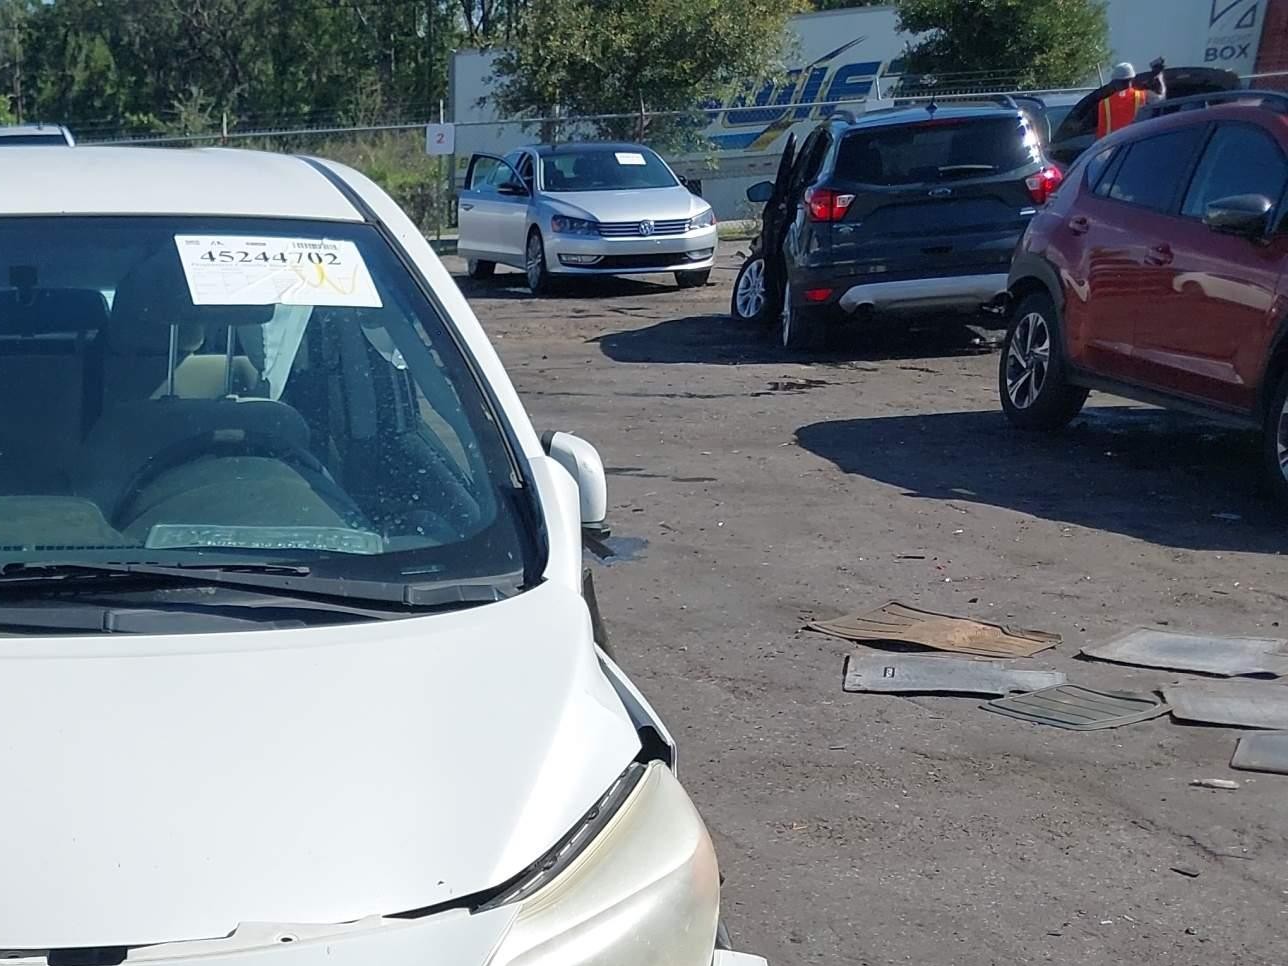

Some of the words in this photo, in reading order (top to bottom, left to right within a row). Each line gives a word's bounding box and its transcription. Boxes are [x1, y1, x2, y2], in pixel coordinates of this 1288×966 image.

[1204, 43, 1251, 62] BOX
[436, 132, 445, 144] 2
[199, 250, 343, 266] 45244702
